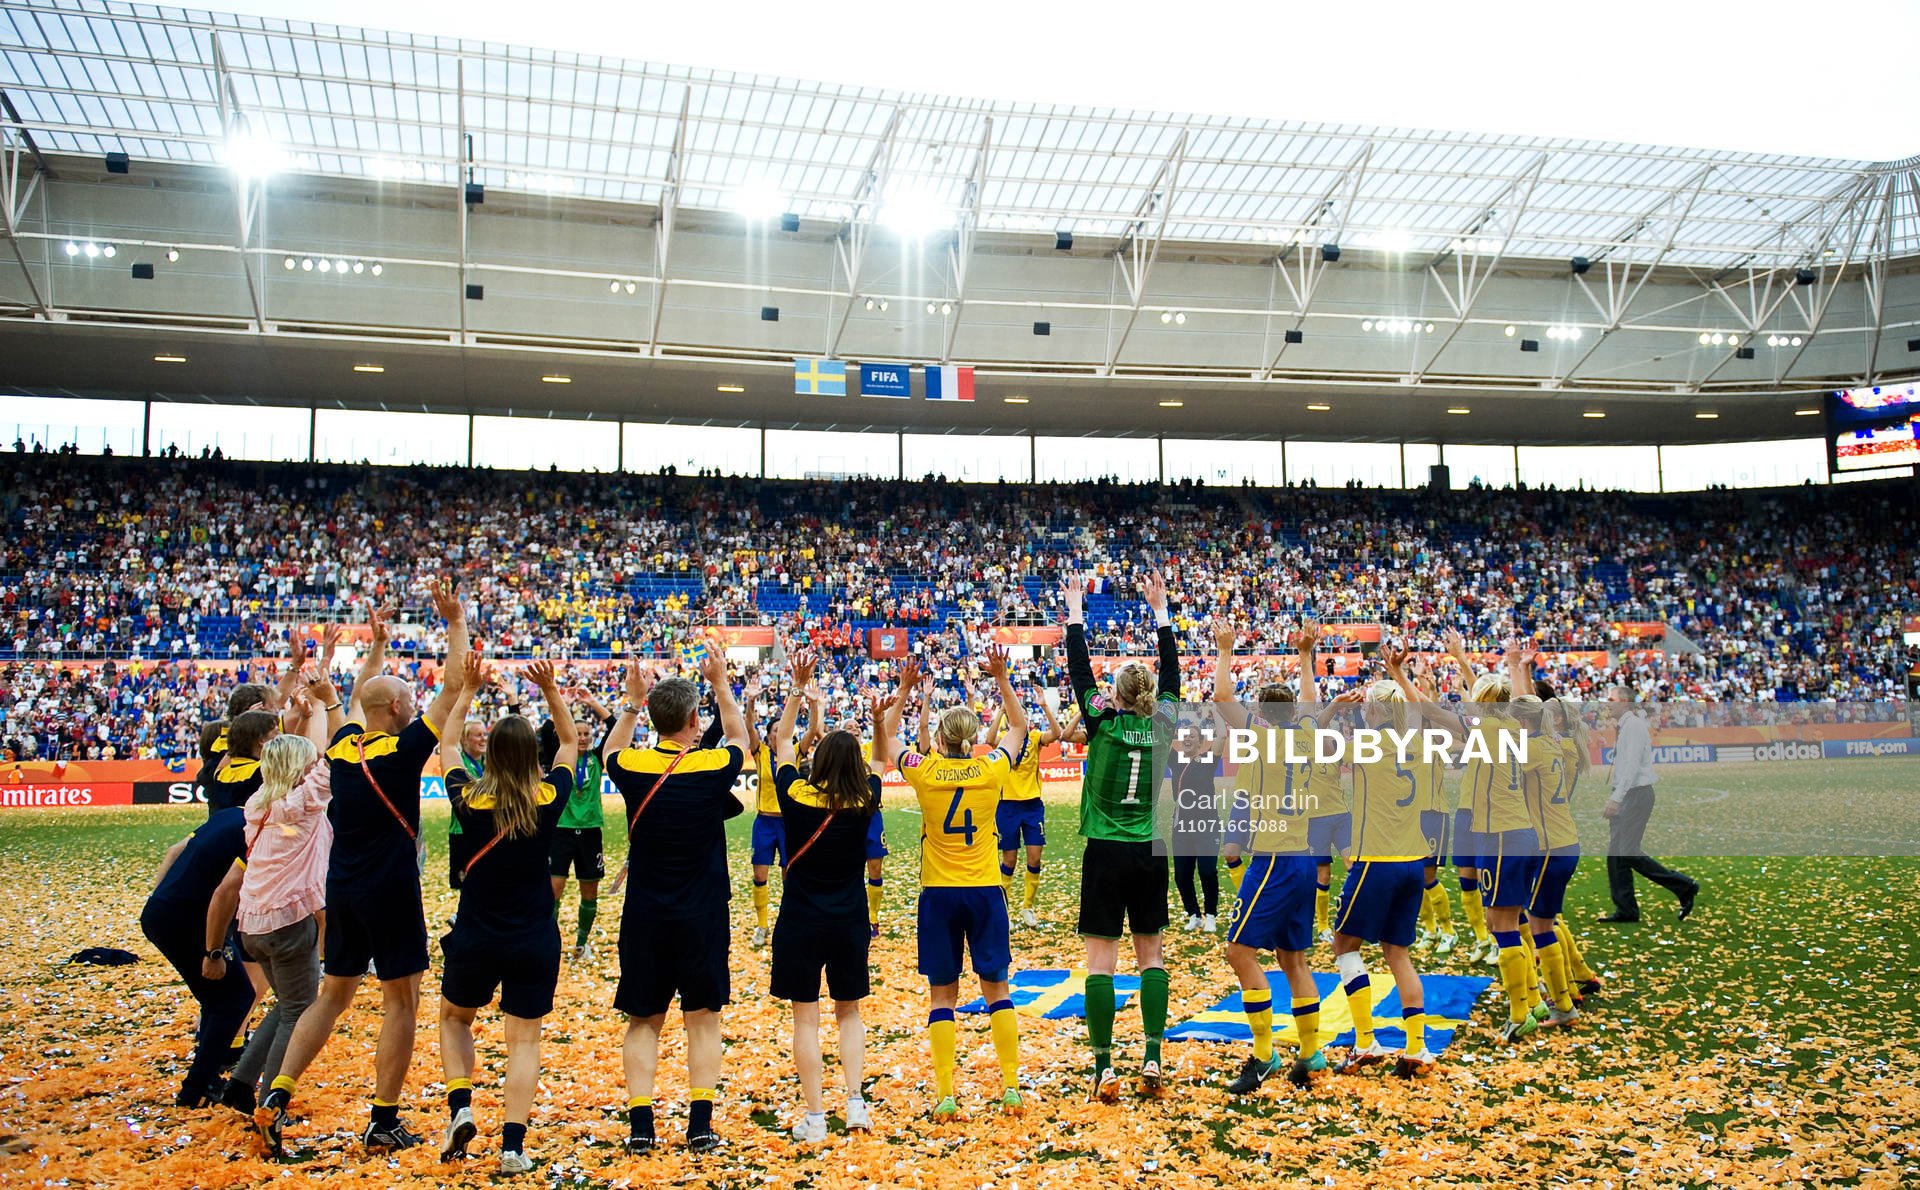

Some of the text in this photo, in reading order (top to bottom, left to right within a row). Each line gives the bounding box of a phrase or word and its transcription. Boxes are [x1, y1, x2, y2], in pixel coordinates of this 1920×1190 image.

[871, 371, 899, 382] FIFA
[687, 458, 696, 467] K
[1217, 469, 1226, 478] M
[1651, 746, 1710, 763] YUNDAI
[1755, 741, 1820, 761] adidas
[935, 765, 982, 781] SVENSSON
[1121, 750, 1142, 804] 1
[1395, 751, 1416, 807] 5
[0, 785, 93, 806] mirates
[943, 787, 978, 846] 4
